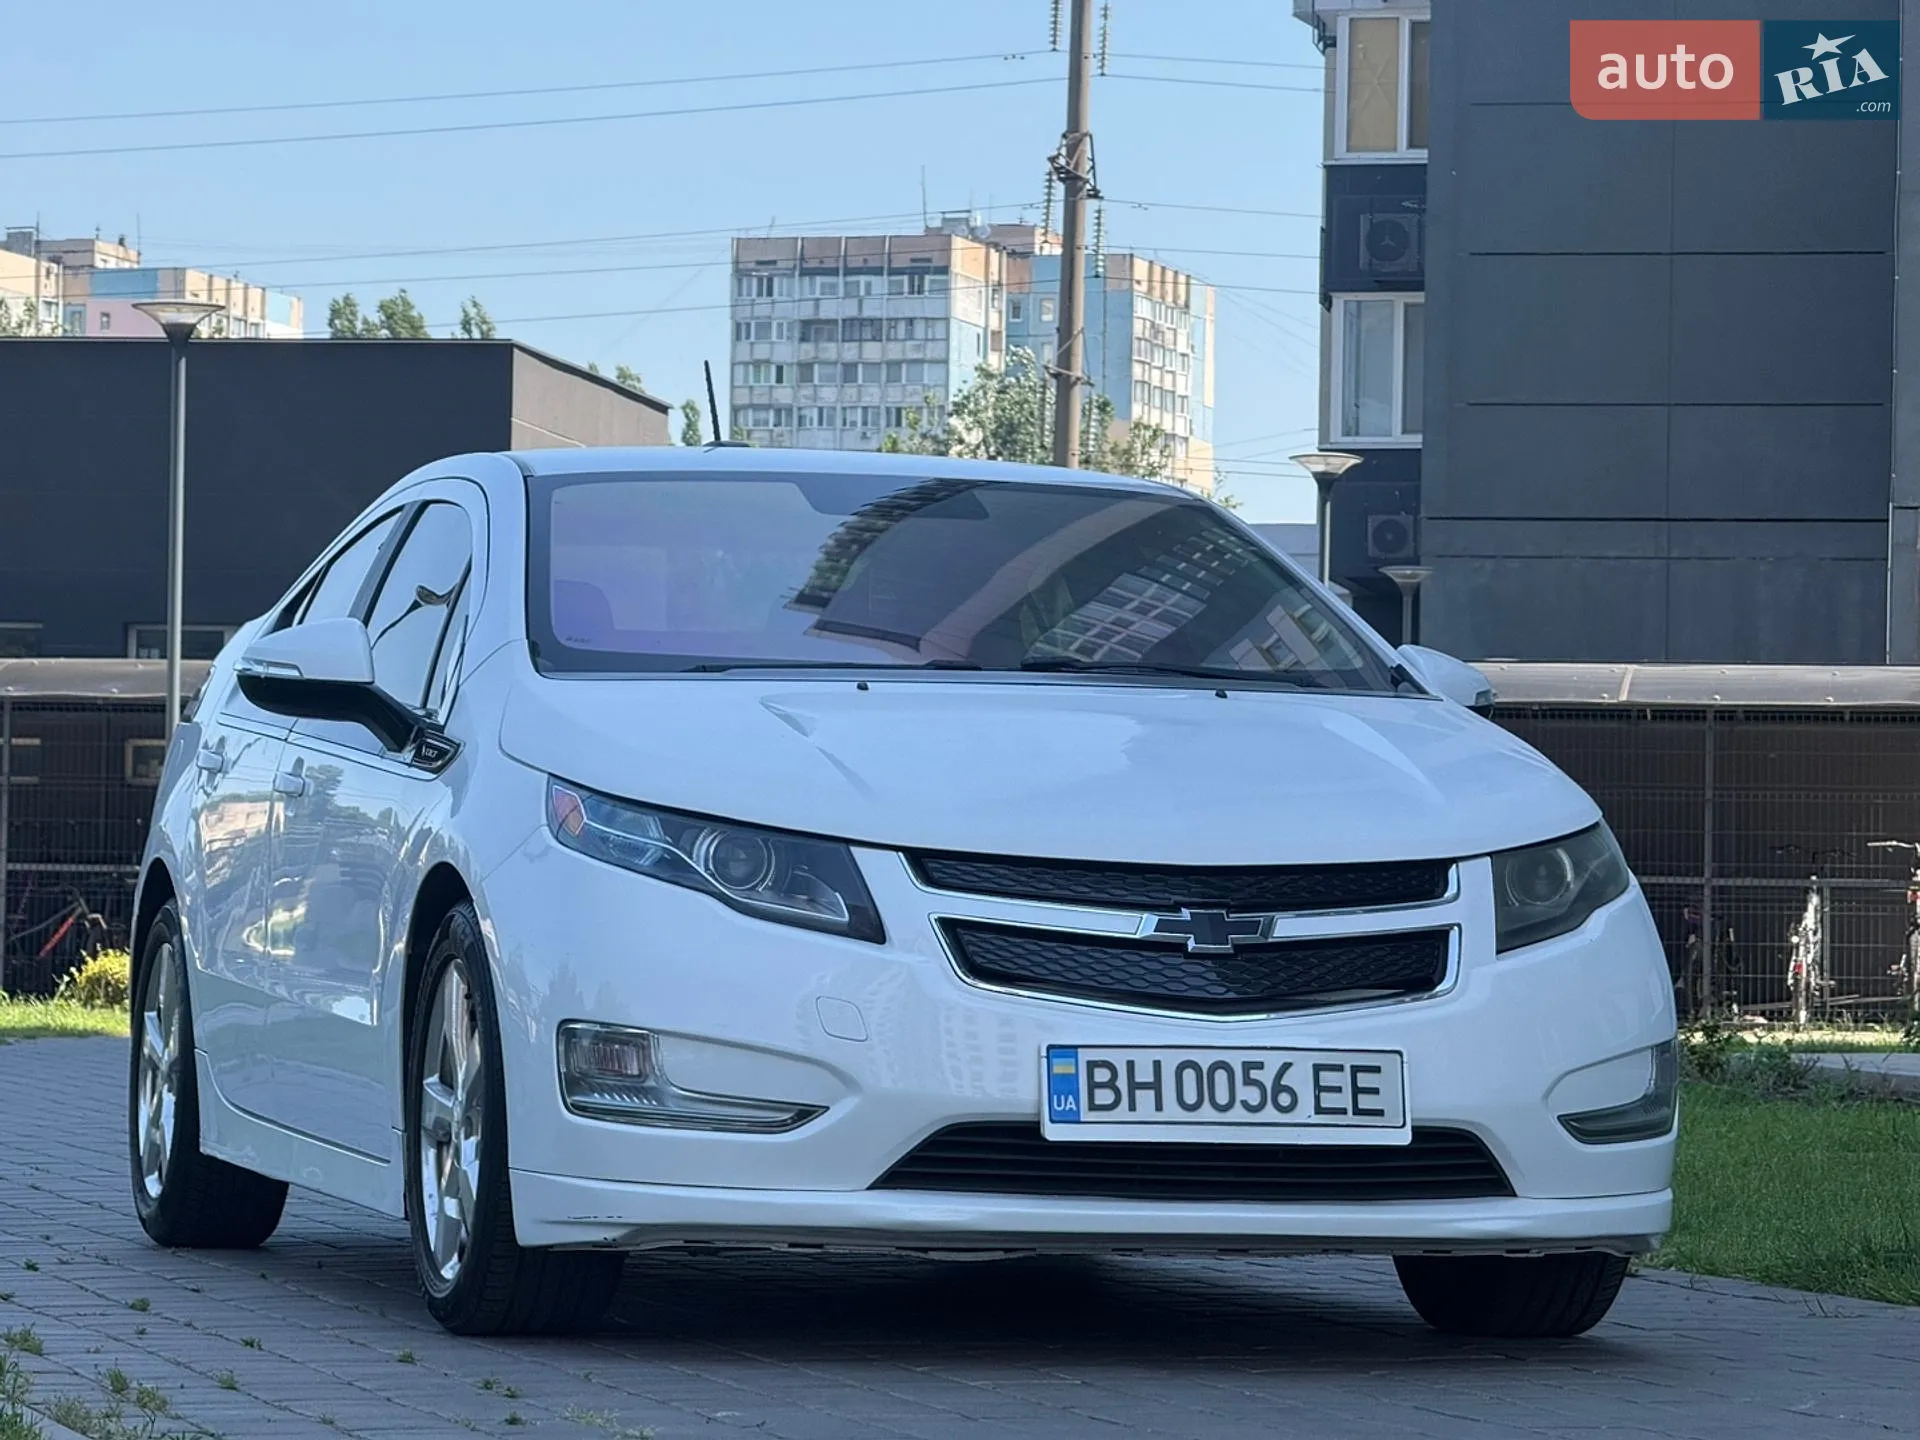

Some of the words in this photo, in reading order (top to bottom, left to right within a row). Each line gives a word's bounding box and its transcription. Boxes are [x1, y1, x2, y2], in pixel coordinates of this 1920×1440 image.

[1052, 1094, 1078, 1112] UA
[1085, 1058, 1164, 1113] BH
[1174, 1058, 1299, 1115] 0056
[1311, 1062, 1386, 1118] EE
